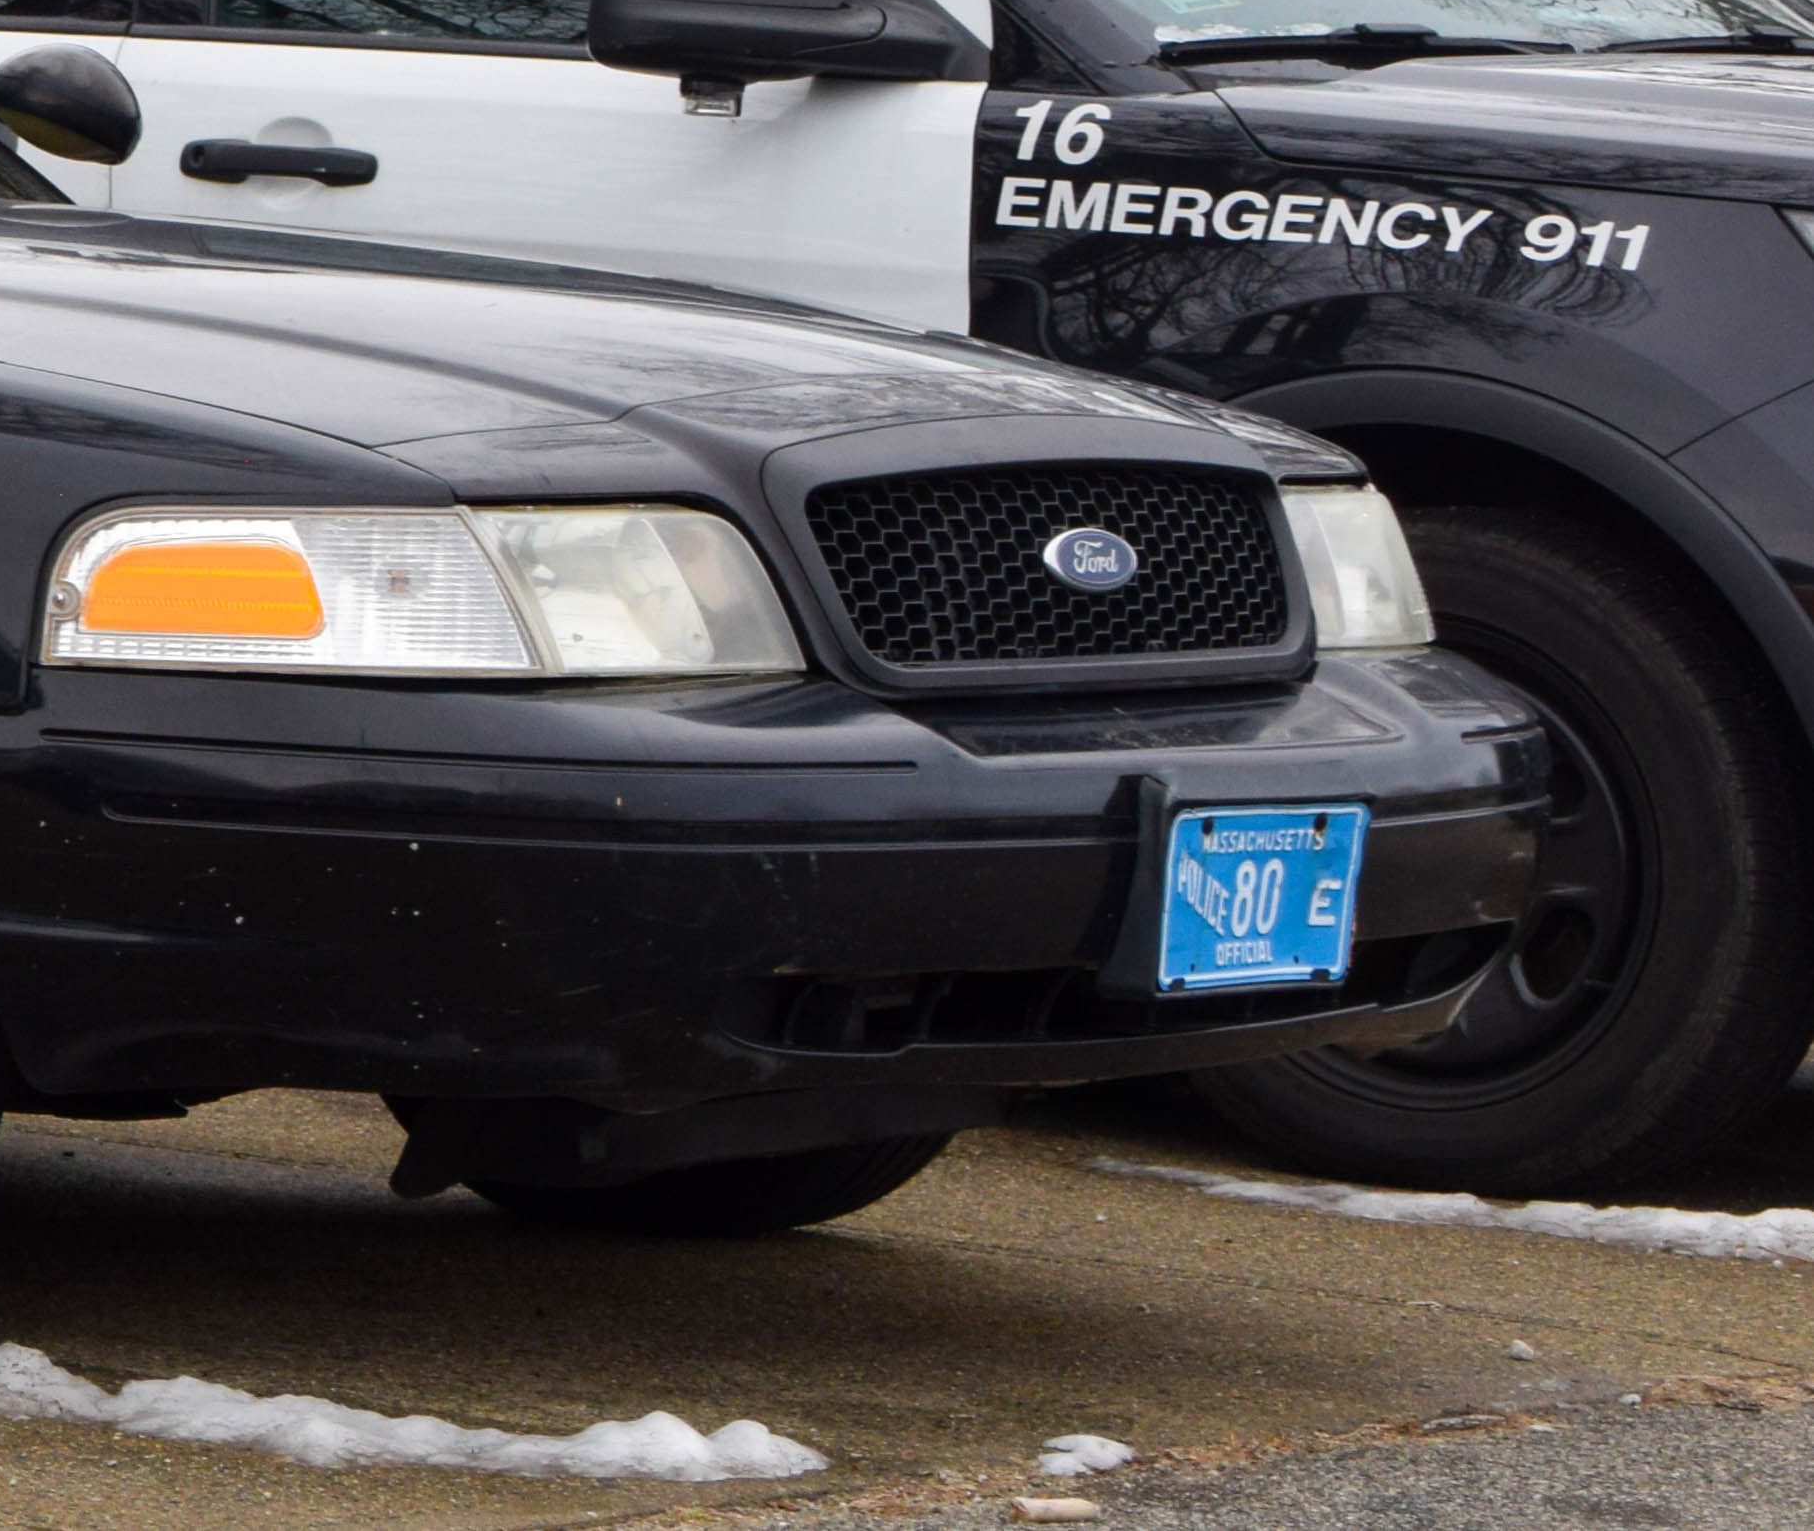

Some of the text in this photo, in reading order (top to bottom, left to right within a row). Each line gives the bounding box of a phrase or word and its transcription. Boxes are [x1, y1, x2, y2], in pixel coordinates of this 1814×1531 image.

[1013, 99, 1112, 165] 16
[995, 177, 1650, 270] EMERGENCY 911
[1074, 540, 1119, 574] Ford
[1203, 828, 1325, 853] MASSACHUSETTS
[1178, 849, 1230, 936] POLICE
[1230, 858, 1342, 938] 80 E
[1215, 940, 1274, 966] OFFICIAL
